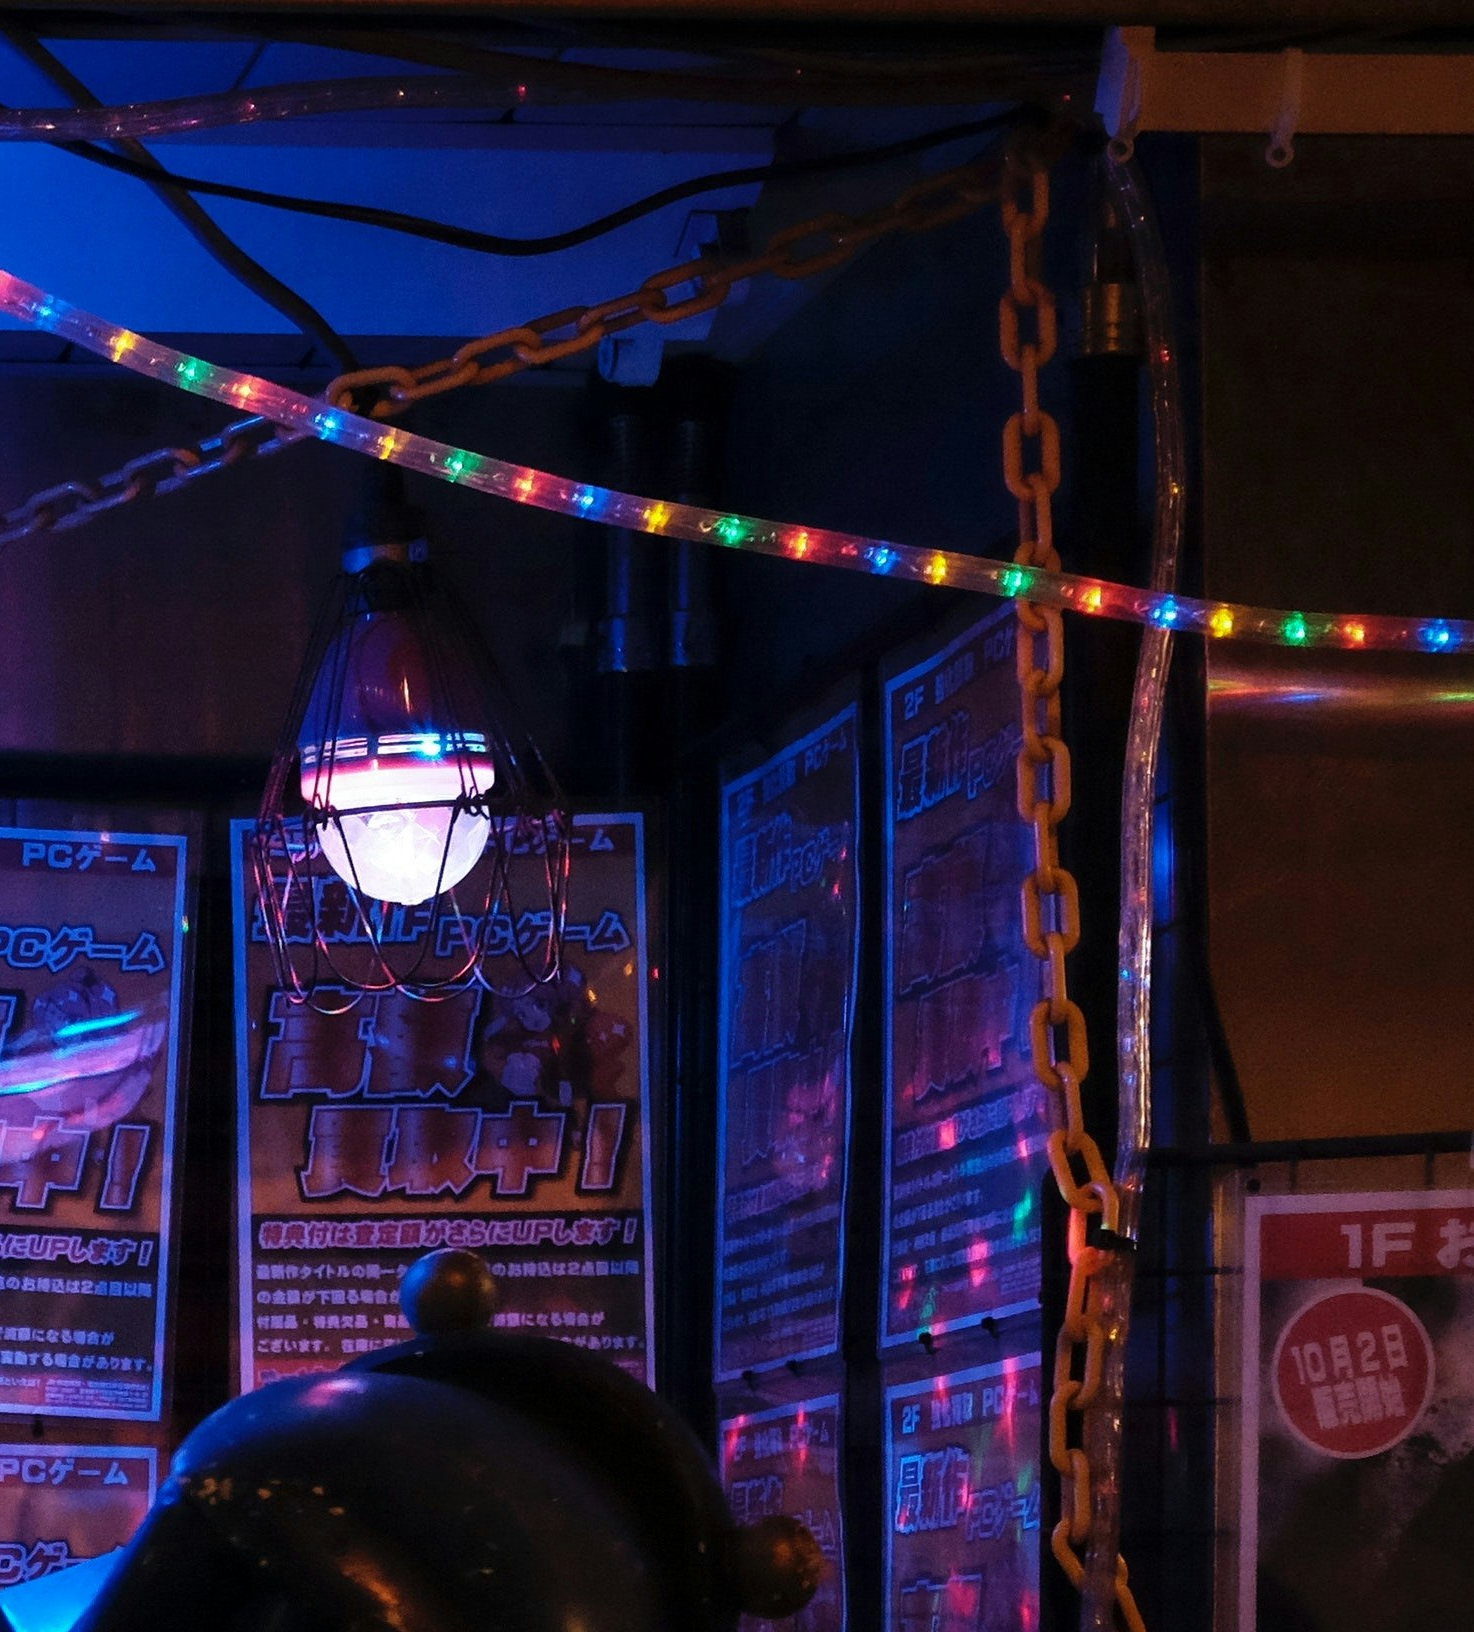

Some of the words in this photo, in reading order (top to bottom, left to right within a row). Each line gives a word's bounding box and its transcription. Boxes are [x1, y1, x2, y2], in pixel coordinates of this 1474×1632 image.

[24, 839, 159, 874] PCゲーム
[1340, 1222, 1417, 1268] 1F
[1291, 1323, 1409, 1386] 10月2日
